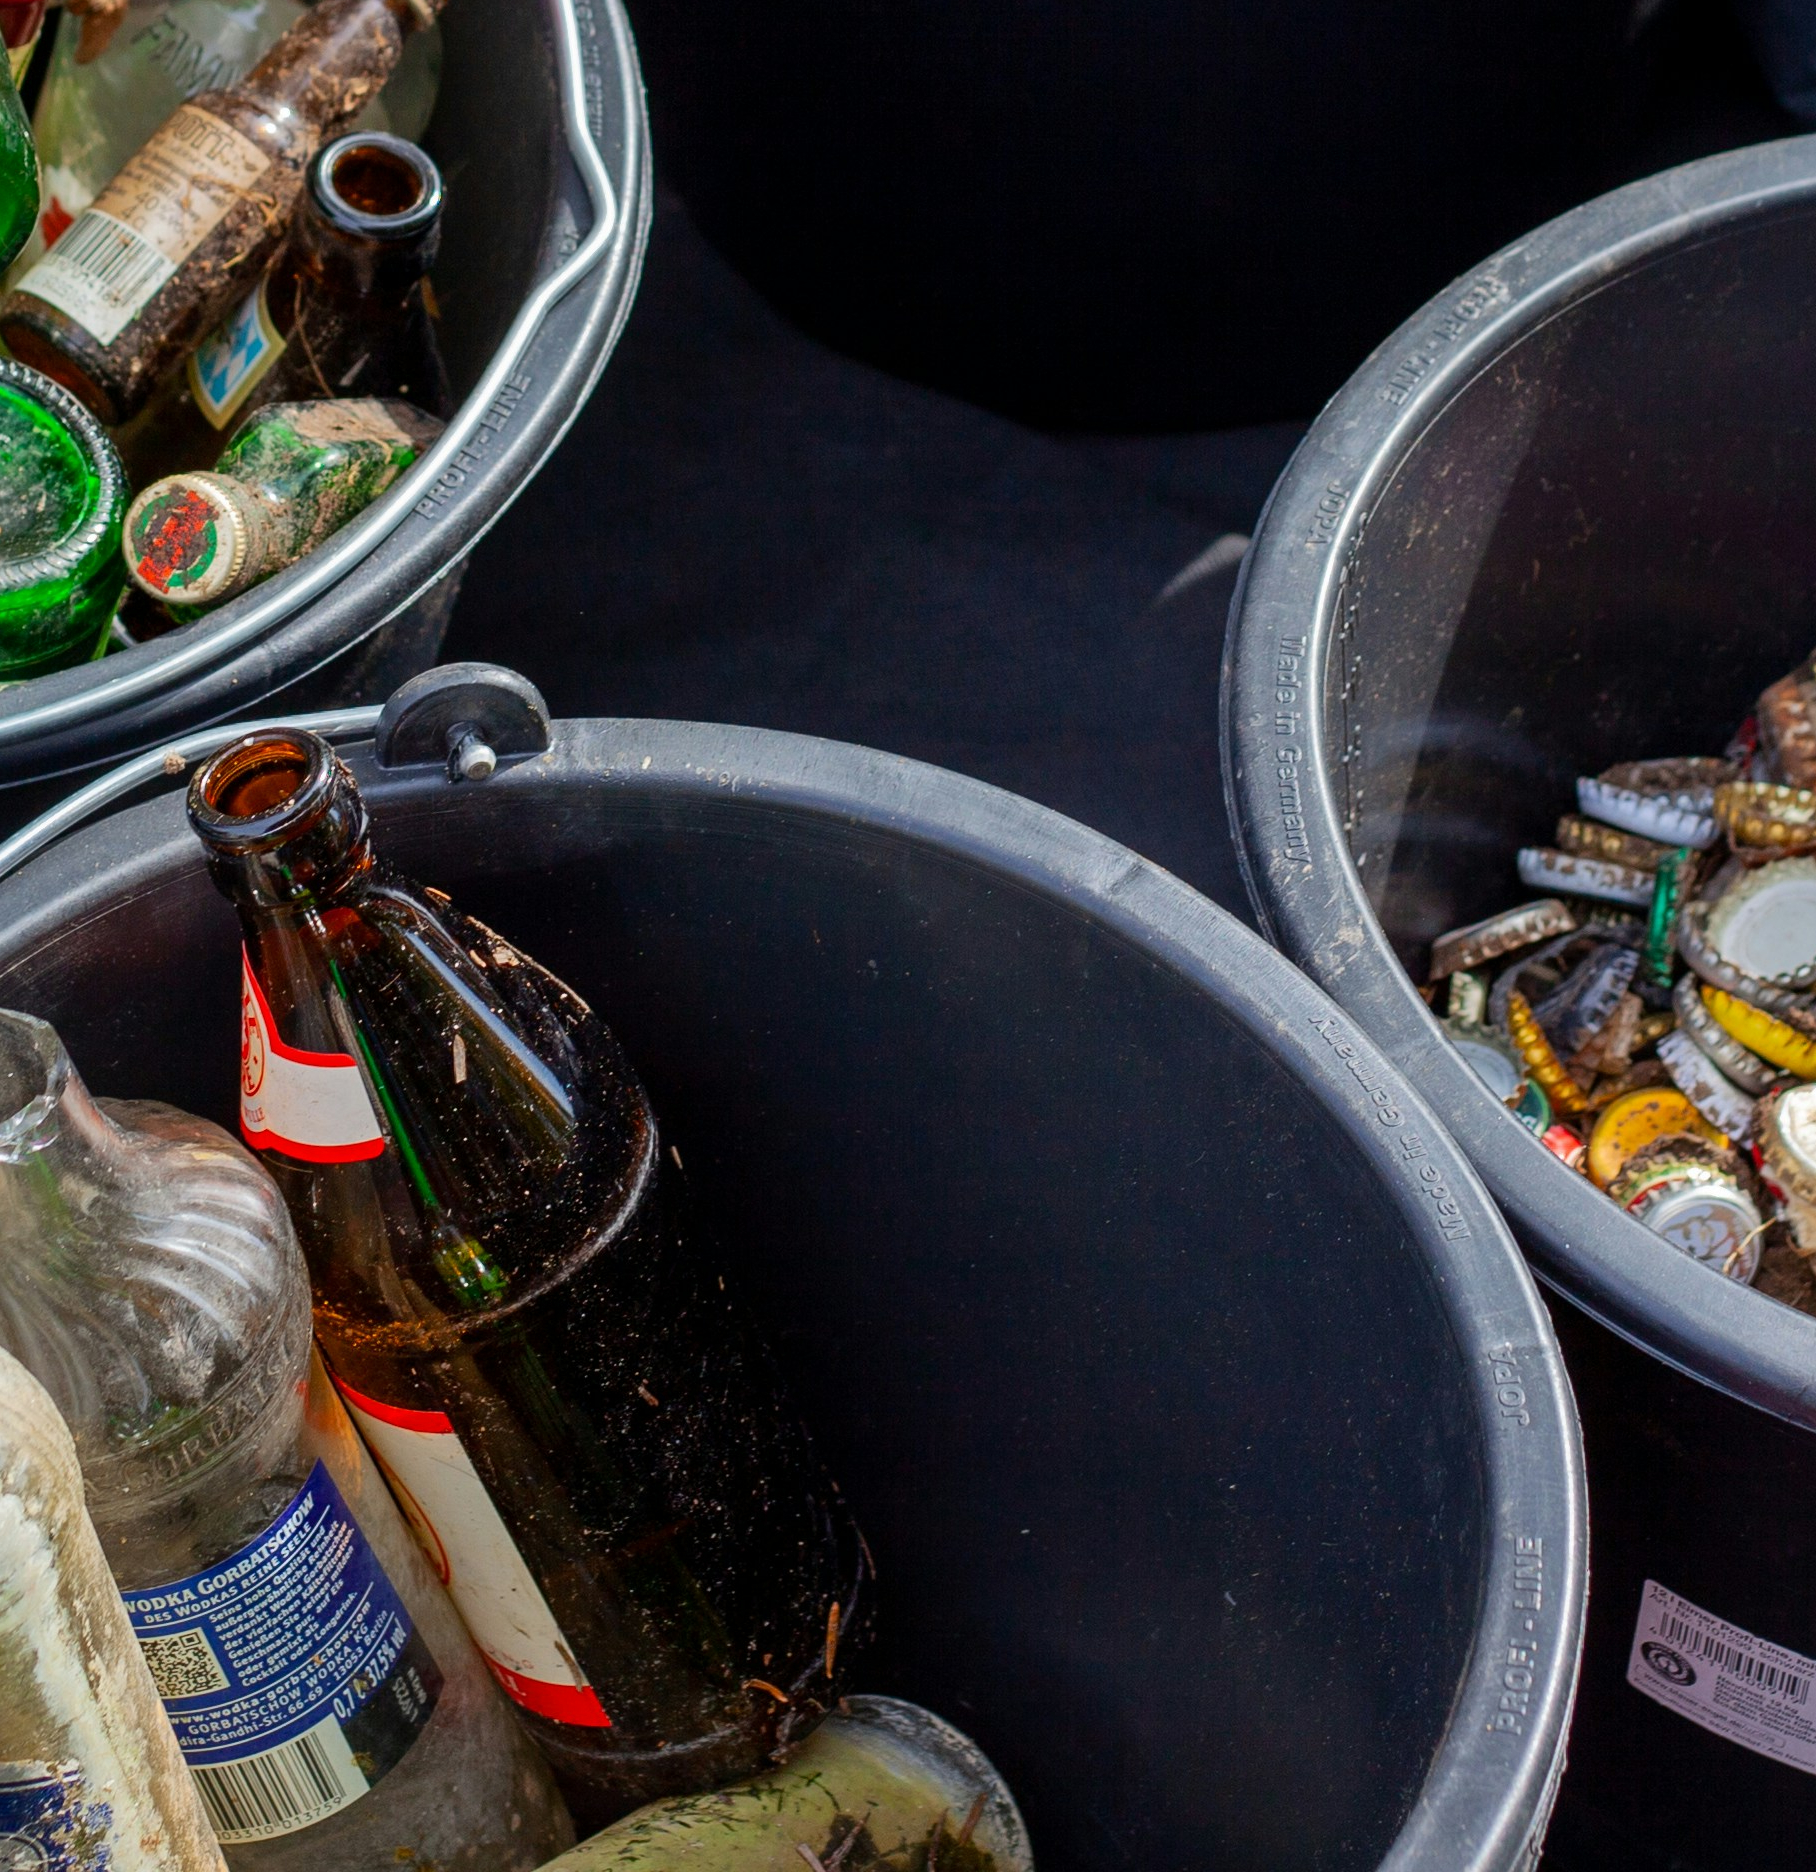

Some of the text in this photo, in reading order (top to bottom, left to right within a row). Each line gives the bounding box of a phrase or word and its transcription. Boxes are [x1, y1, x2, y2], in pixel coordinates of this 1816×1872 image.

[1307, 1012, 1473, 1243] Made in Germany
[1487, 1341, 1531, 1428] JOPA
[144, 1521, 312, 1625] DES WODKAS REINE SEELE
[197, 1490, 315, 1596] GORBATSCHOW
[209, 1524, 327, 1624] Seine hohe Qualität und
[1512, 1535, 1545, 1614] LINE
[219, 1610, 270, 1641] verdankt
[270, 1584, 304, 1614] Wodka
[223, 1636, 244, 1651] der
[246, 1600, 302, 1640] vierfachen
[228, 1627, 283, 1660] Genießen
[283, 1613, 301, 1629] Sie
[301, 1581, 332, 1615] seinen
[233, 1631, 295, 1669] Geschmack
[315, 1593, 332, 1615] auf
[331, 1579, 345, 1597] Eis
[237, 1621, 321, 1679] oder gemixt als
[188, 1622, 370, 1736] GORBATSCHOW WODKA KG
[241, 1658, 289, 1688] Cocktail
[289, 1640, 315, 1662] oder
[287, 1687, 325, 1715] 66-69
[333, 1647, 364, 1682] 13053
[362, 1609, 389, 1646] Berlin
[1489, 1626, 1537, 1737] PROFI
